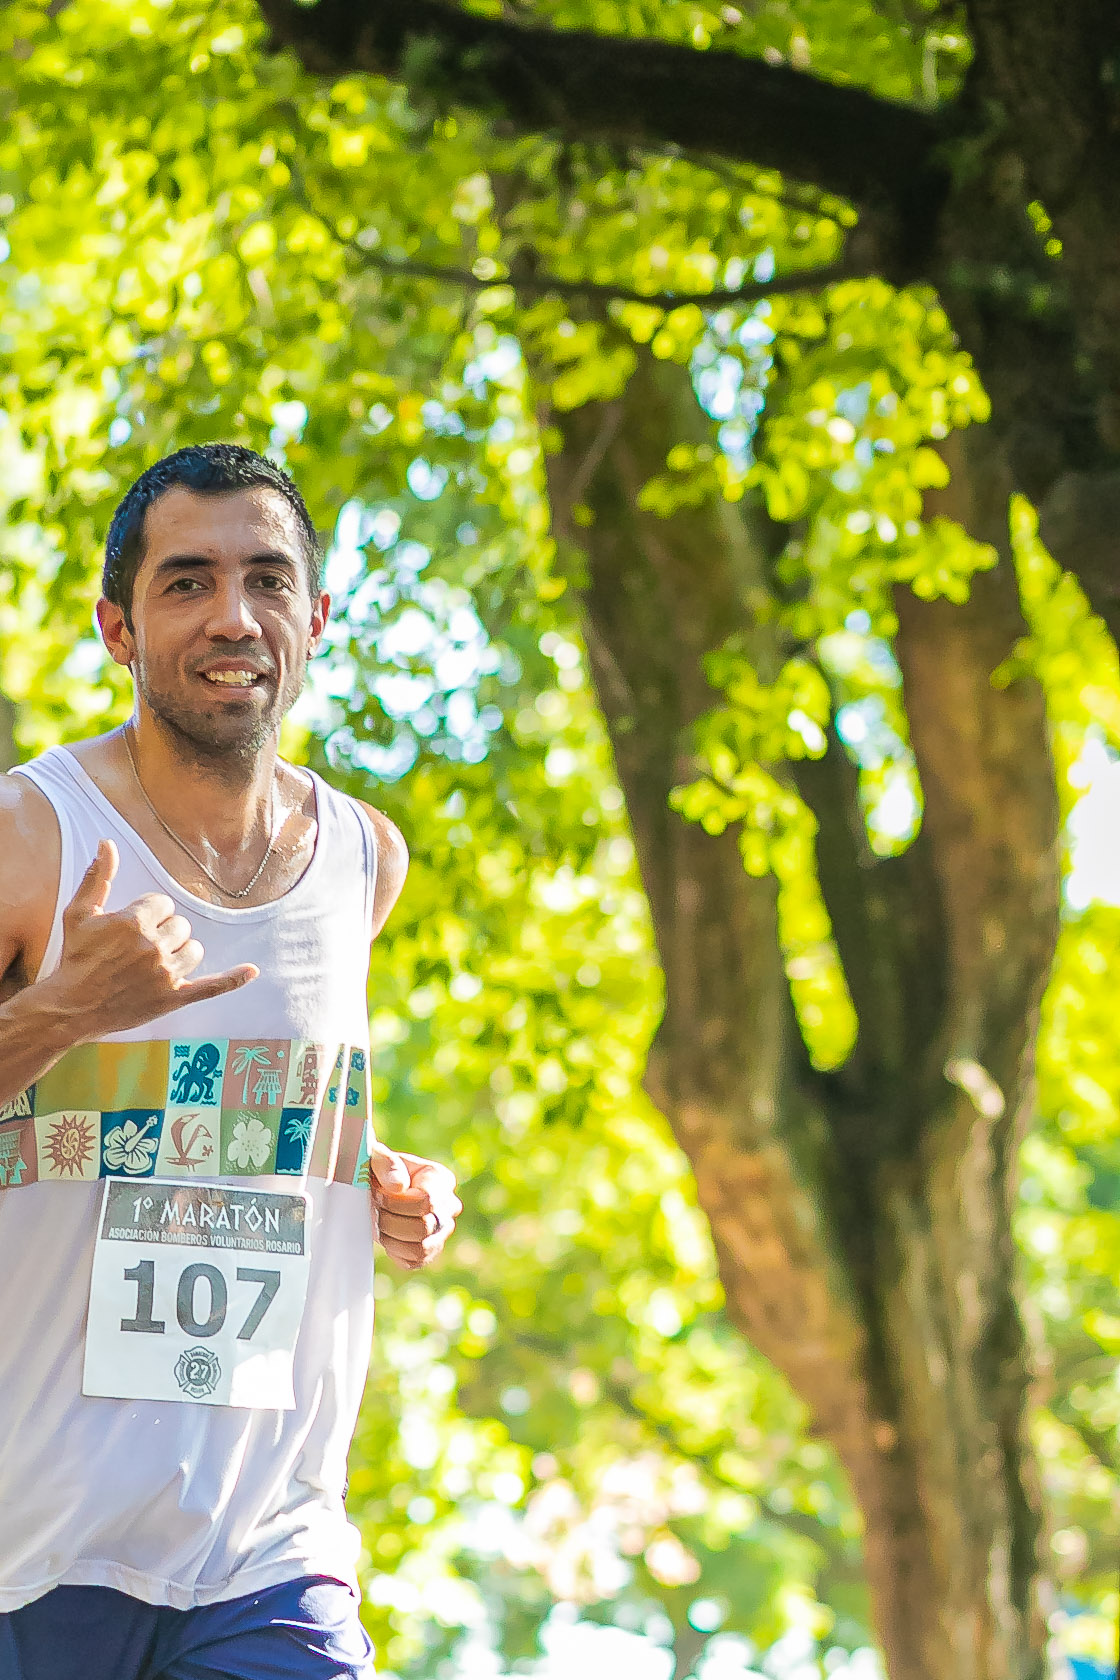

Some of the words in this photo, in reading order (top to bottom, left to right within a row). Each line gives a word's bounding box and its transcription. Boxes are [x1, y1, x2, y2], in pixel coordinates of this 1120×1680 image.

[159, 1196, 280, 1234] MARATÓN
[108, 1226, 159, 1241] ASOCIACIÓN
[161, 1231, 208, 1246] BOMBEROS
[210, 1235, 265, 1251] VOLUNTARIOS
[266, 1240, 301, 1254] ROSARIO
[120, 1259, 281, 1340] 107
[190, 1361, 209, 1380] 27
